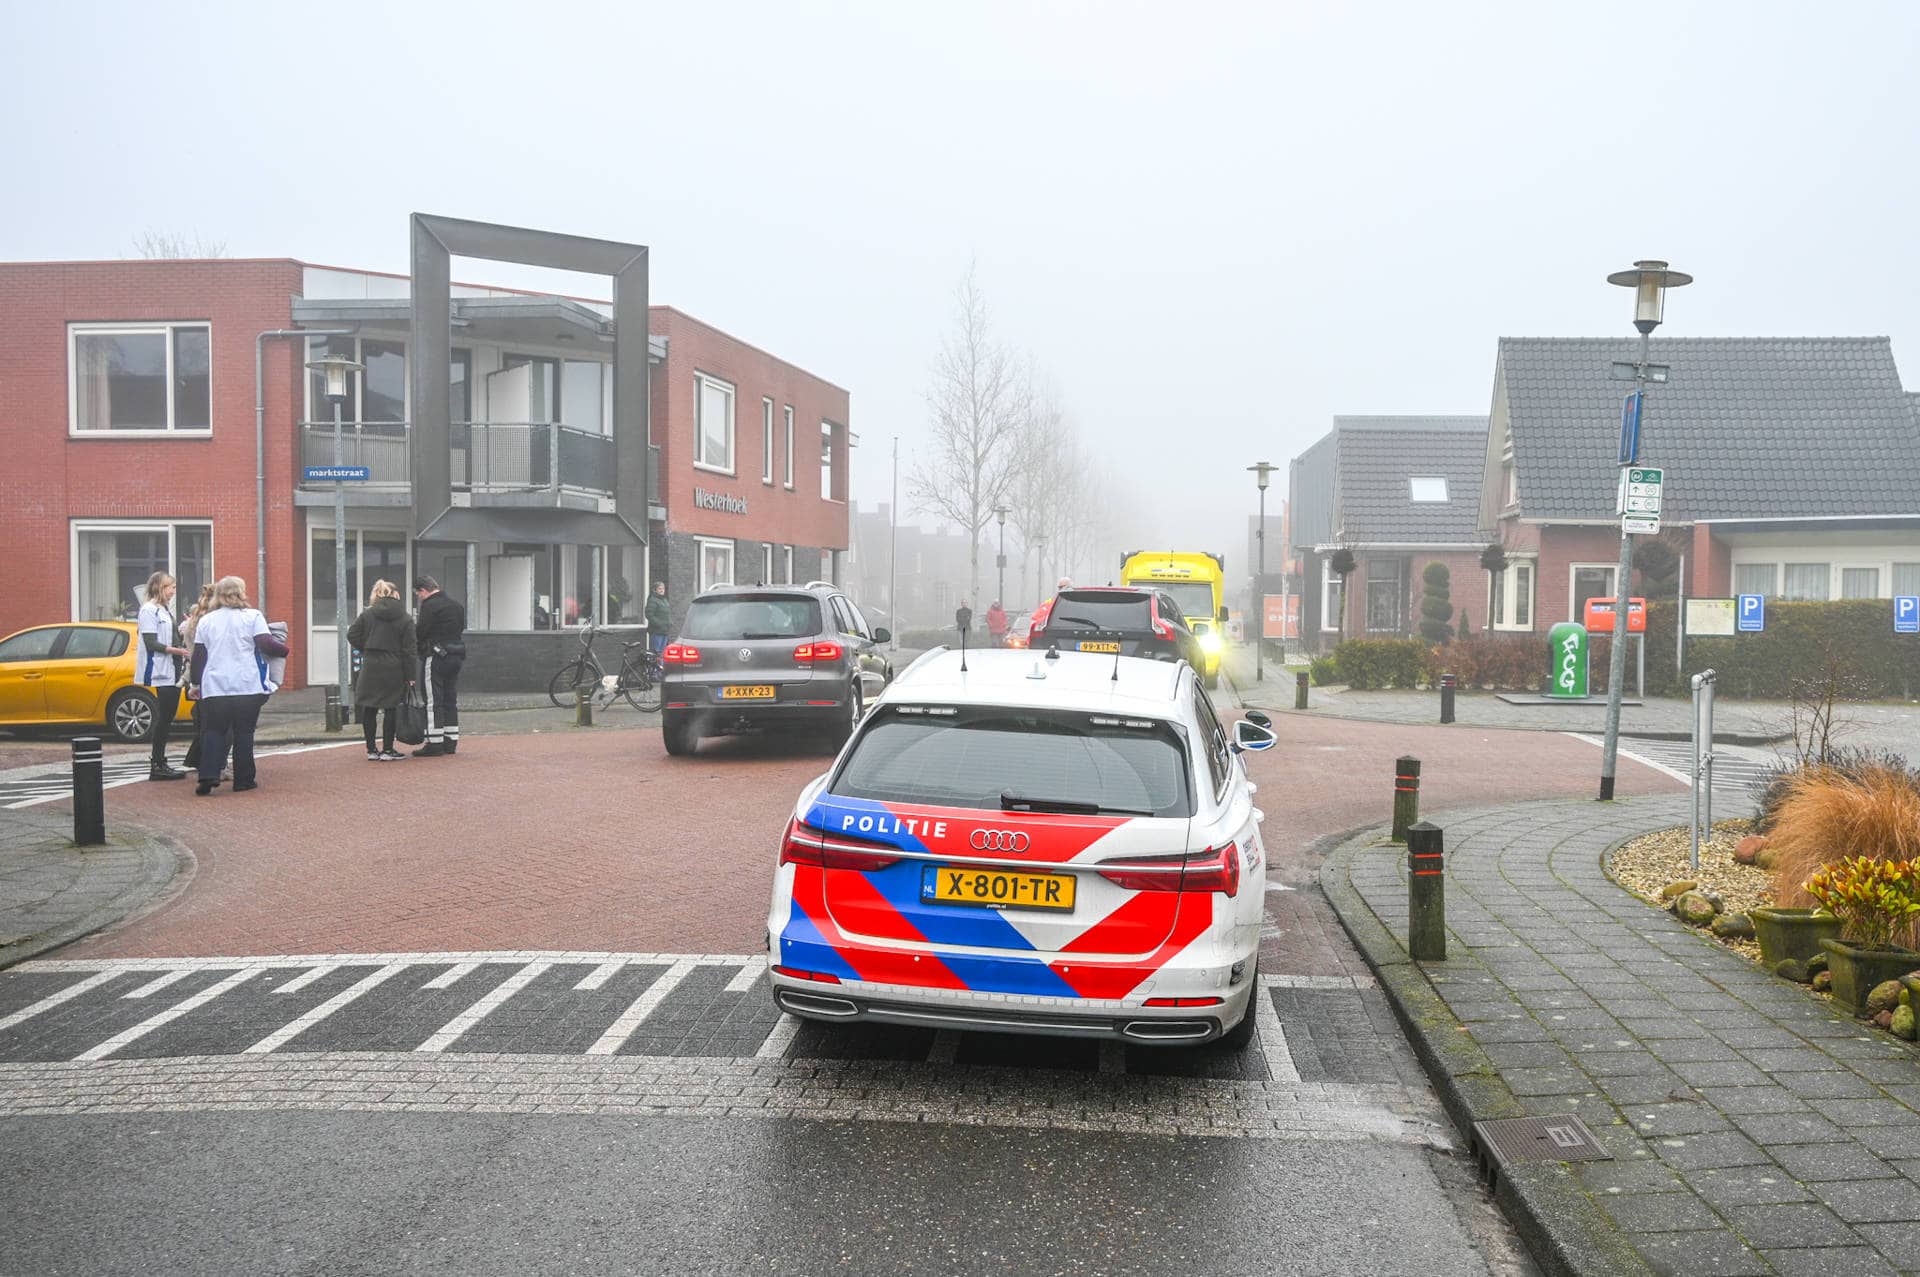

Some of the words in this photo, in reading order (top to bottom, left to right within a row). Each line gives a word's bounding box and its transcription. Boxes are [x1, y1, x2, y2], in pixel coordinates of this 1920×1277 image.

[309, 469, 364, 477] marktstraat
[694, 487, 748, 514] Westerhoek
[1744, 597, 1758, 616] P
[1900, 599, 1914, 617] P
[725, 685, 771, 697] 4-XXK-23
[842, 815, 947, 838] POLITIE
[923, 885, 934, 894] NL
[948, 873, 1060, 902] X-801-TR
